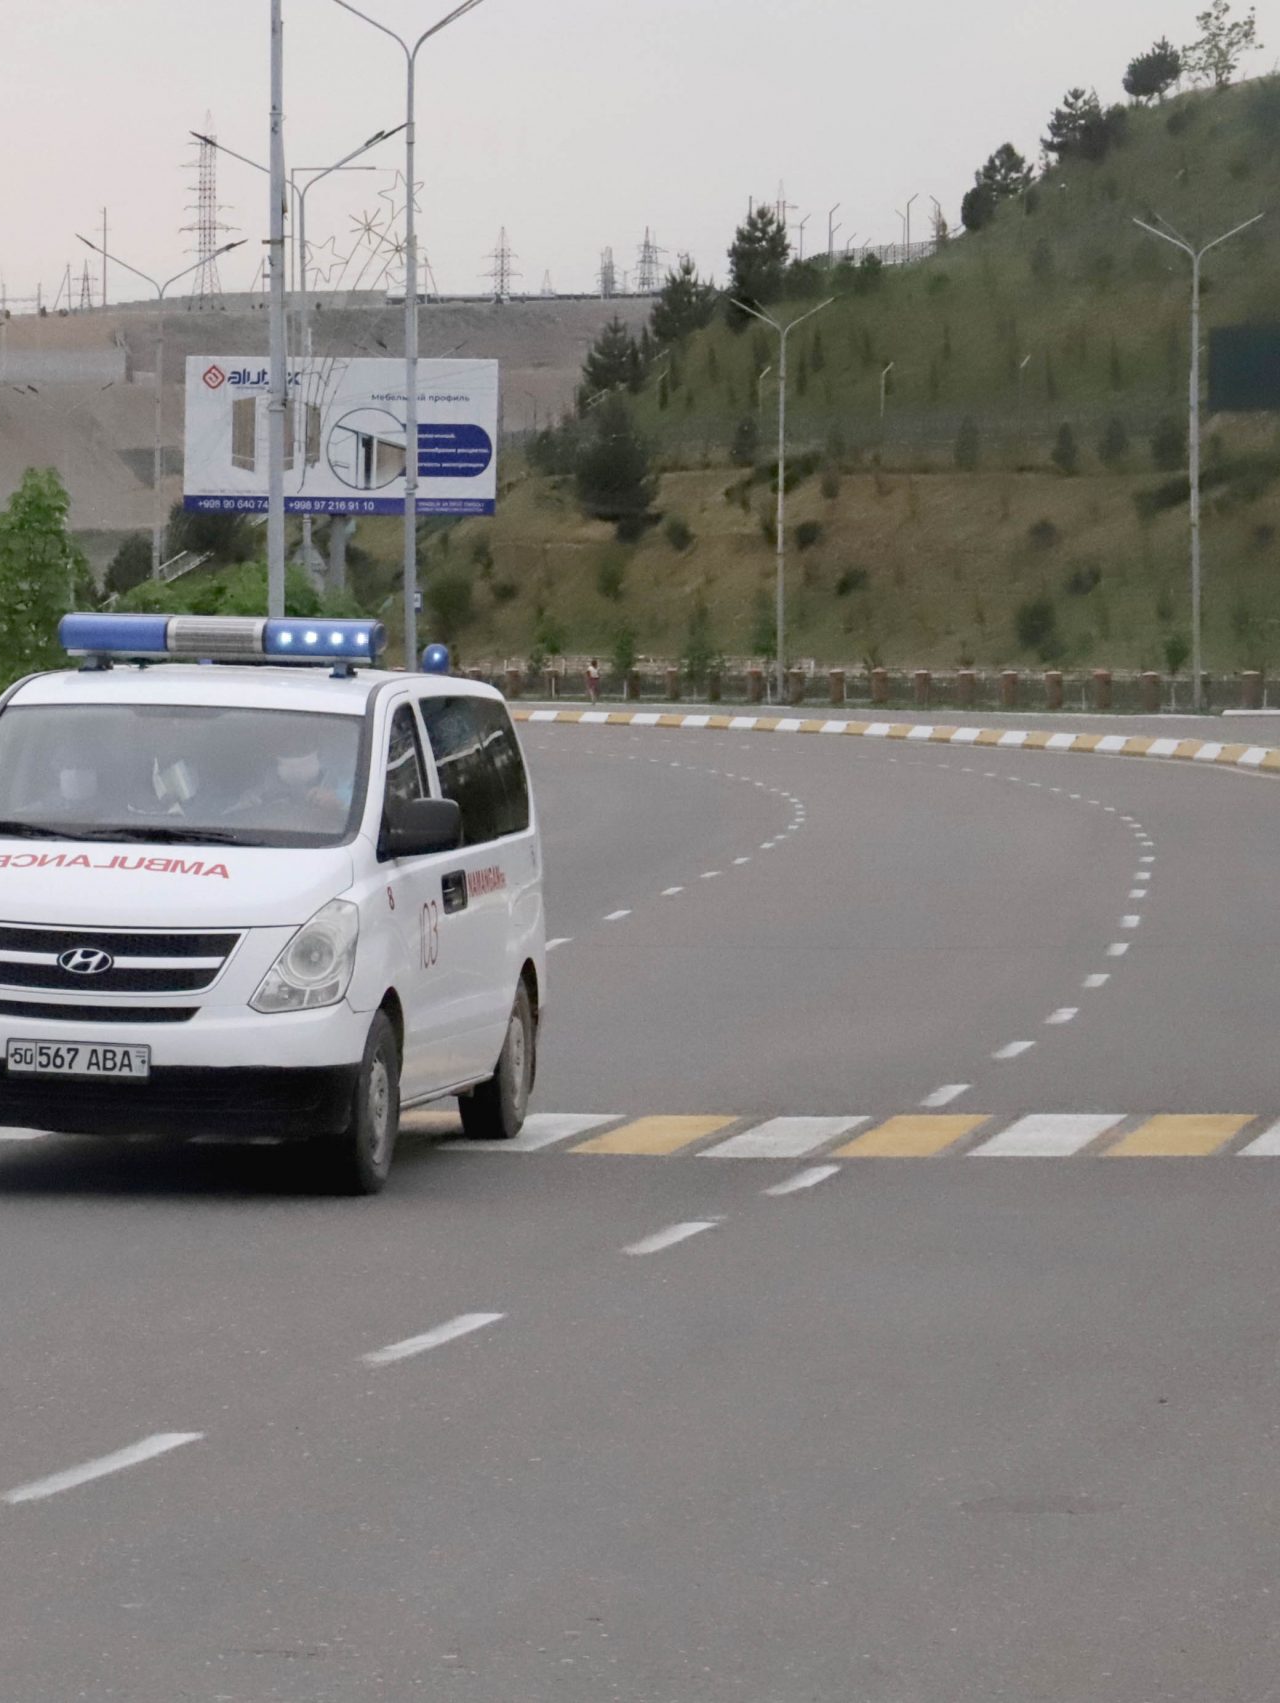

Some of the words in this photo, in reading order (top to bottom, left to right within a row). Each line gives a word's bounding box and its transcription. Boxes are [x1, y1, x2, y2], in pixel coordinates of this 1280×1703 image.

[228, 368, 301, 385] alutx
[429, 393, 470, 403] профиль
[314, 501, 326, 510] 97
[328, 501, 346, 510] 216
[348, 501, 359, 510] 91
[363, 501, 375, 511] 10
[38, 1046, 80, 1069] 567
[87, 1049, 133, 1072] ABA
